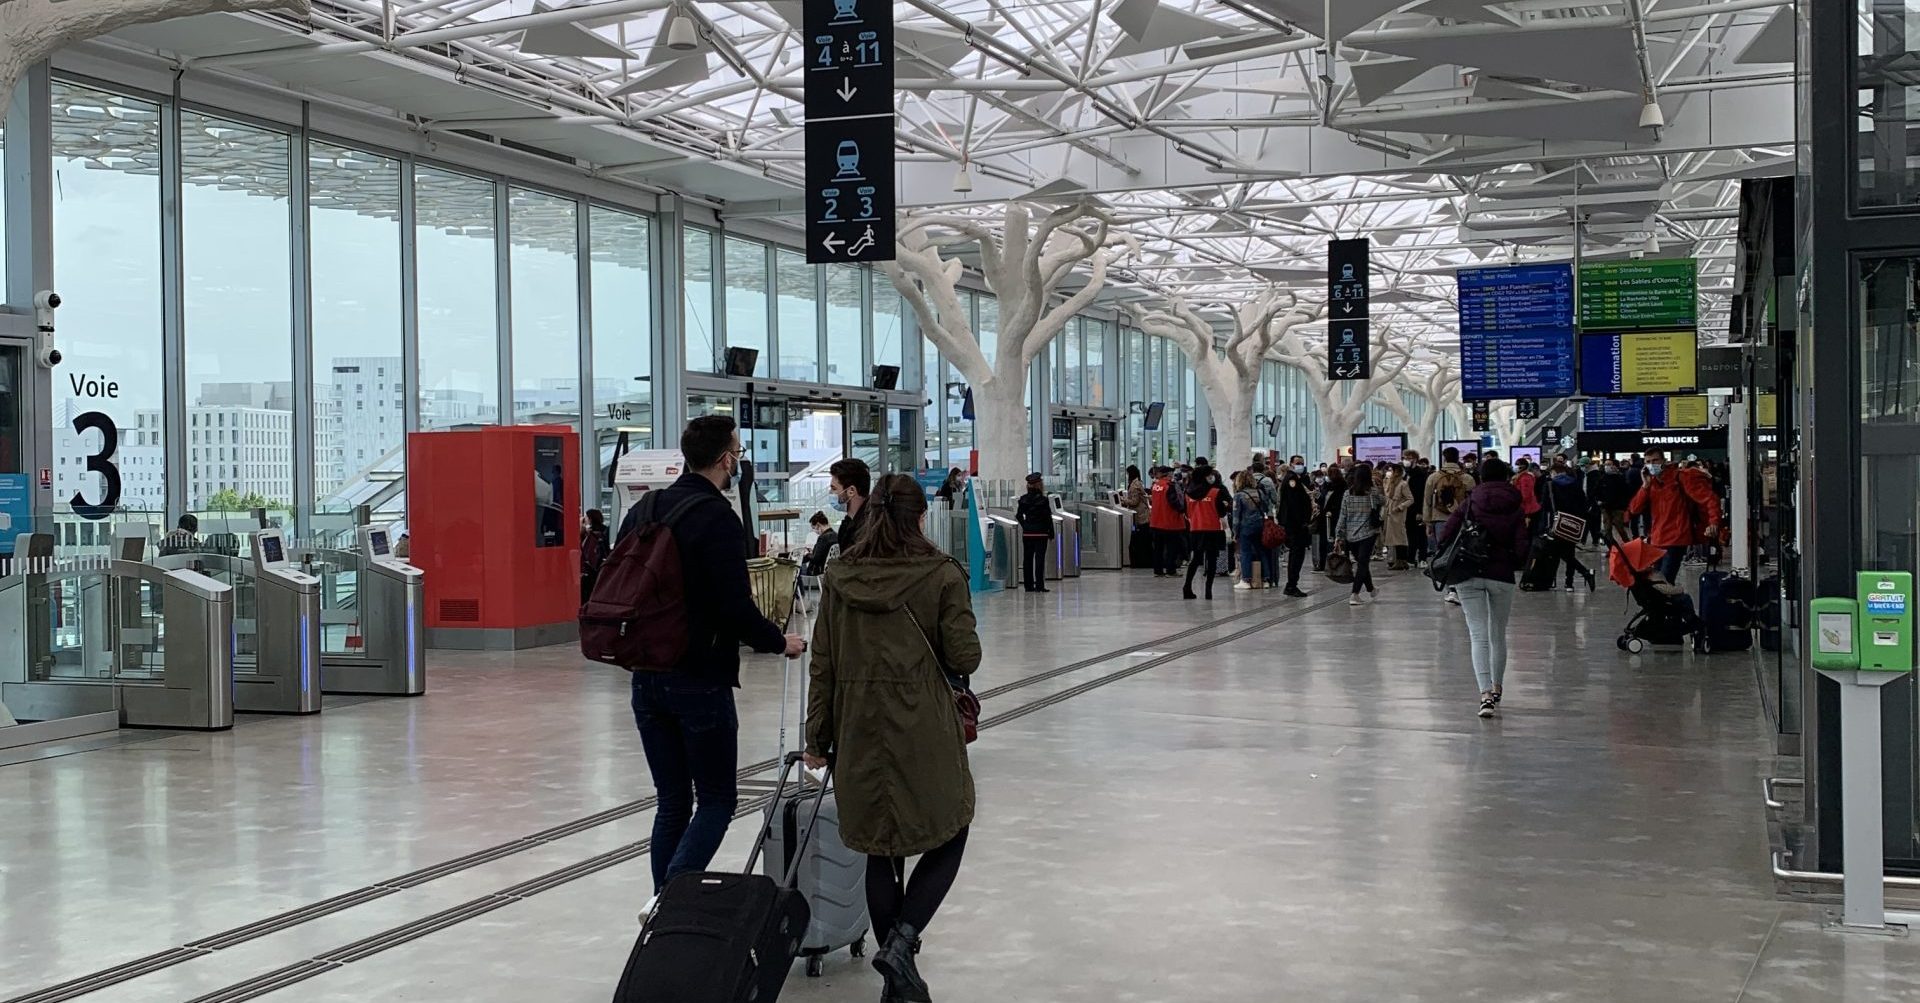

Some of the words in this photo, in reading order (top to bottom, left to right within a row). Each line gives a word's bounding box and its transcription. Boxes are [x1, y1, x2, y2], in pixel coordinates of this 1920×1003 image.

[816, 35, 832, 44] Voie
[860, 32, 875, 40] Voie
[818, 45, 832, 66] 4
[842, 40, 850, 54] à
[856, 41, 879, 63] 11
[824, 198, 838, 220] 2
[860, 197, 873, 218] 3
[1334, 288, 1342, 298] 6
[1352, 288, 1364, 298] 11
[1336, 352, 1344, 362] 4
[1352, 352, 1360, 361] 5
[1611, 335, 1620, 393] Information
[70, 373, 119, 398] Voie
[608, 404, 631, 420] Voie
[70, 412, 121, 520] 3
